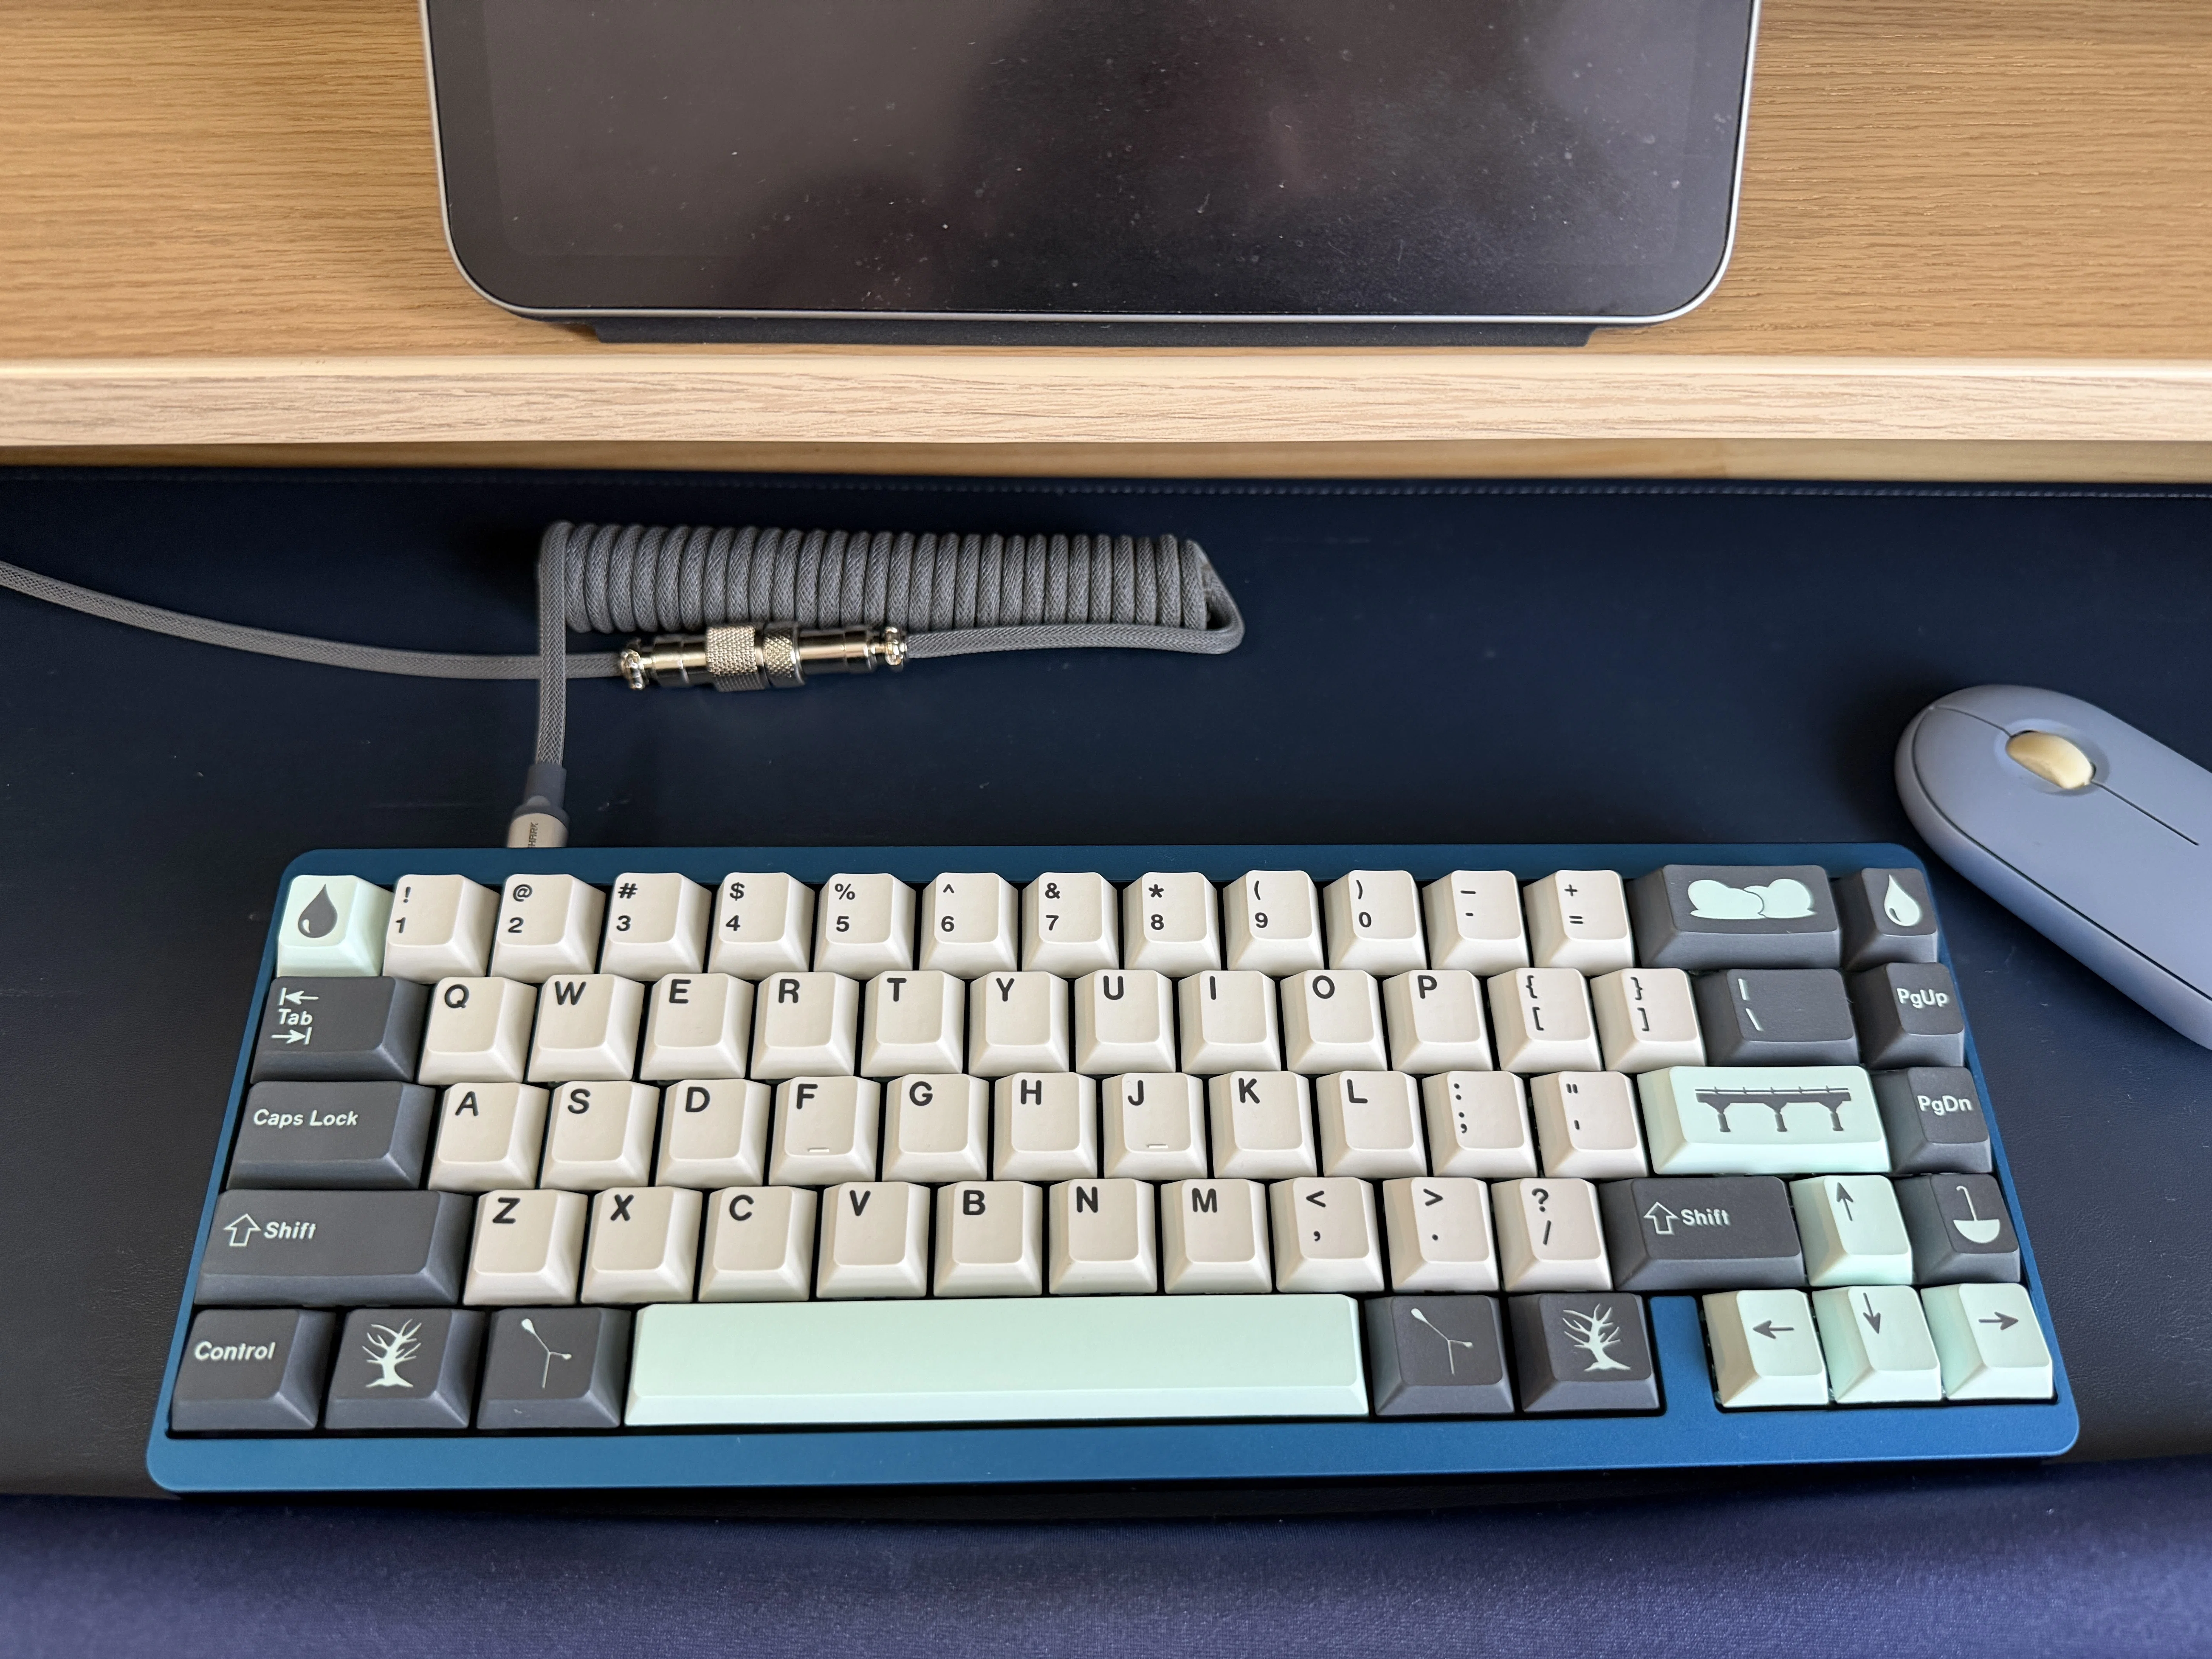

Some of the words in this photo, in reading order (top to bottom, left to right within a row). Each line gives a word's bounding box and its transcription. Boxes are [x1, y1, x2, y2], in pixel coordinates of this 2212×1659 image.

[403, 886, 411, 903] !
[513, 884, 532, 902] @
[618, 883, 638, 899] #
[730, 882, 745, 901] $
[835, 883, 855, 900] %
[1045, 883, 1060, 899] &
[1254, 880, 1261, 900] (
[1356, 879, 1363, 900] )
[1565, 884, 1578, 896] +
[396, 917, 406, 933] 1
[508, 917, 524, 933] 2
[616, 915, 631, 931] 3
[725, 915, 740, 931] 4
[836, 916, 850, 932] 5
[941, 915, 955, 932] 6
[1046, 915, 1059, 931] 7
[1151, 914, 1164, 930] 8
[1255, 912, 1268, 928] 9
[1358, 912, 1372, 928] 0
[1569, 915, 1583, 924] =
[444, 984, 469, 1009] Q
[555, 981, 586, 1005] W
[669, 979, 691, 1004] E
[778, 979, 800, 1004] R
[887, 977, 907, 1002] T
[996, 977, 1015, 1002] Y
[1103, 975, 1124, 1000] U
[1209, 975, 1217, 1000] I
[1312, 975, 1335, 999] O
[1417, 975, 1437, 999] P
[1525, 975, 1538, 999] {
[1630, 977, 1643, 1001] }
[1897, 988, 1948, 1009] PgUp
[278, 1008, 313, 1025] Tab
[1532, 1006, 1544, 1031] [
[1637, 1007, 1650, 1032] ]
[1745, 1008, 1762, 1031] \
[567, 1089, 591, 1114] S
[685, 1086, 710, 1113] D
[796, 1084, 818, 1109] F
[909, 1081, 933, 1106] G
[1020, 1079, 1042, 1105] H
[1128, 1080, 1144, 1106] J
[1238, 1078, 1260, 1104] K
[1346, 1079, 1368, 1104] L
[1454, 1083, 1462, 1100] :
[455, 1091, 478, 1116] A
[1917, 1095, 1972, 1116] PgDn
[254, 1109, 303, 1128] Caps
[309, 1110, 358, 1126] Lock
[1458, 1112, 1467, 1133] ;
[610, 1194, 634, 1221] X
[729, 1194, 754, 1221] C
[849, 1190, 871, 1216] V
[963, 1190, 986, 1215] B
[1076, 1186, 1098, 1213] N
[1192, 1188, 1218, 1213] M
[1306, 1190, 1326, 1207] <
[1423, 1188, 1443, 1206] >
[1532, 1188, 1549, 1212] ?
[492, 1197, 520, 1224] Z
[1681, 1208, 1729, 1226] Shift
[264, 1221, 316, 1239] Shift
[1314, 1231, 1321, 1242] ,
[1543, 1220, 1551, 1245] /
[194, 1341, 275, 1360] Control
